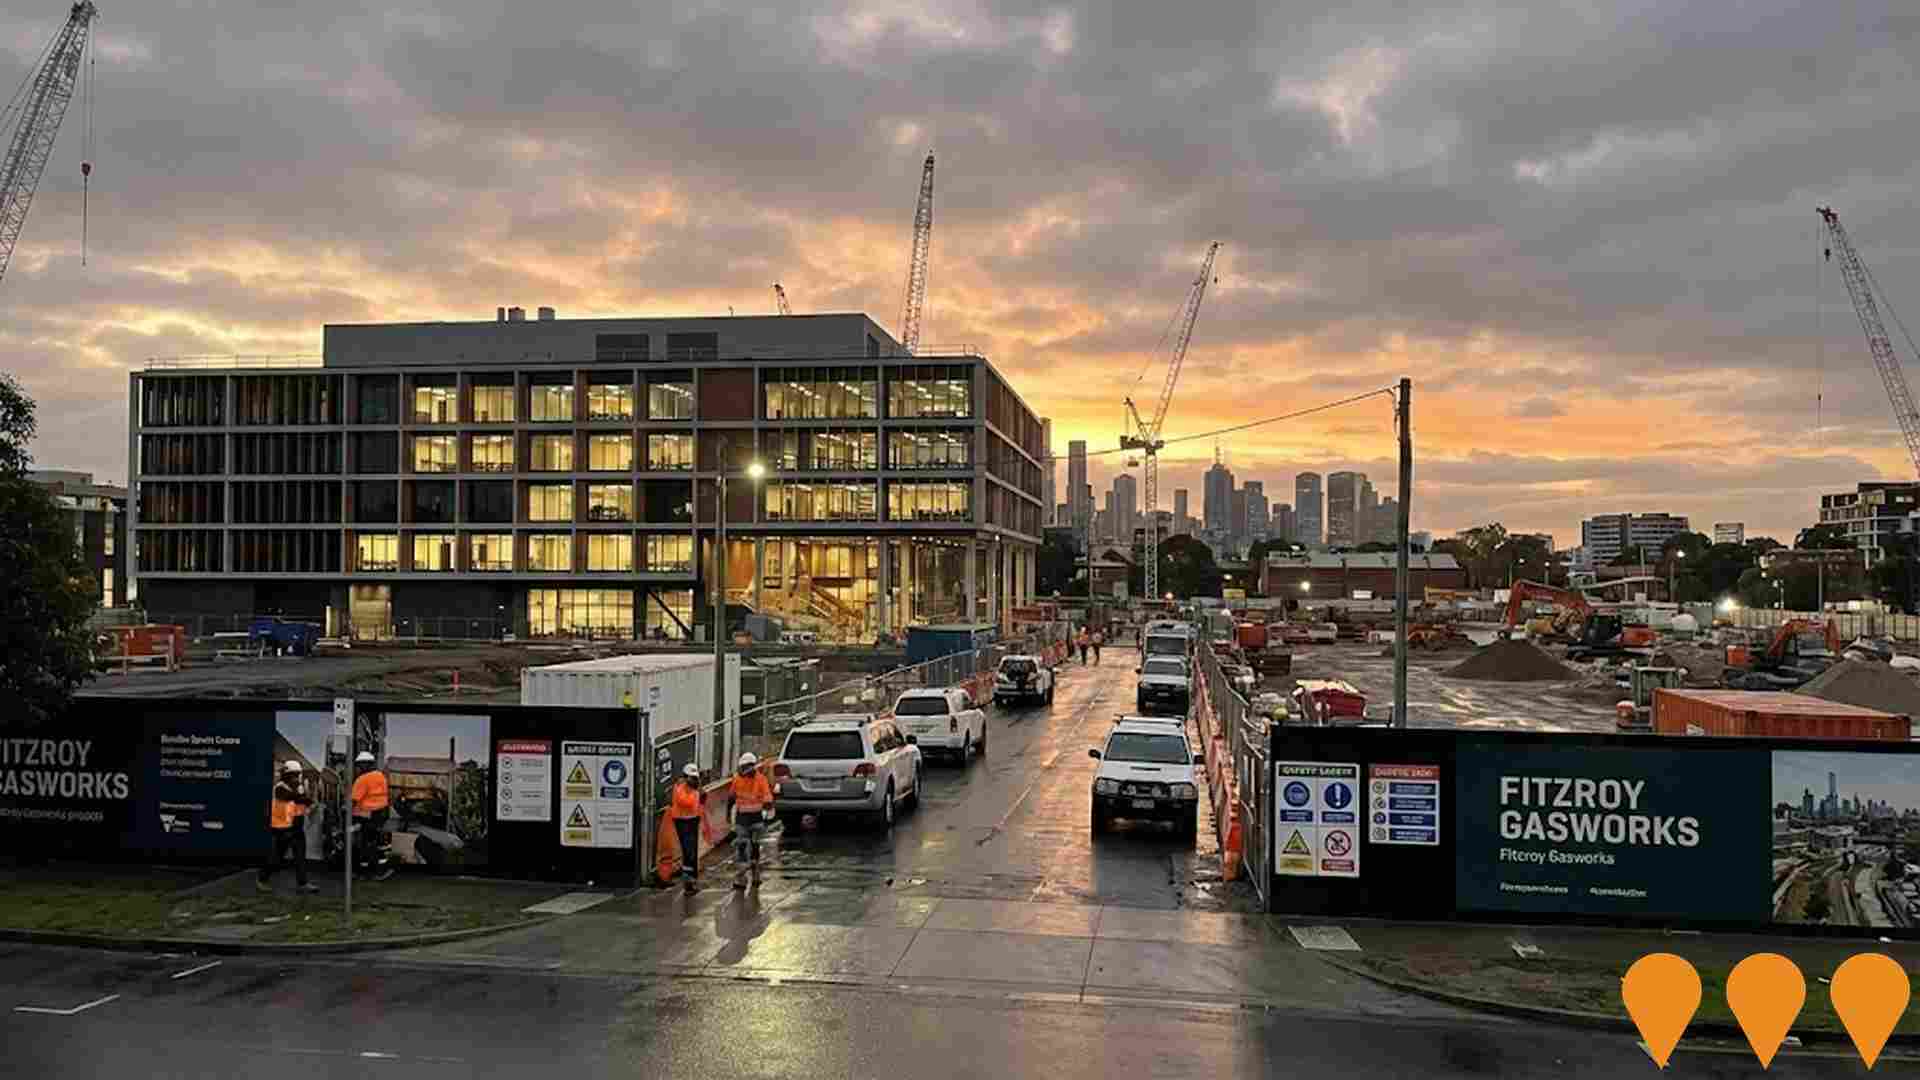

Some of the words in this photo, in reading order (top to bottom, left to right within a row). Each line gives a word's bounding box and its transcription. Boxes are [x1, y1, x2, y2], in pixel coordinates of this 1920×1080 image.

[0, 738, 92, 767] ITZROY
[0, 769, 129, 799] ASWORKS
[1500, 776, 1646, 810] FITZROY
[1500, 809, 1700, 847] GASWORKS
[1549, 849, 1616, 865] Gasworks
